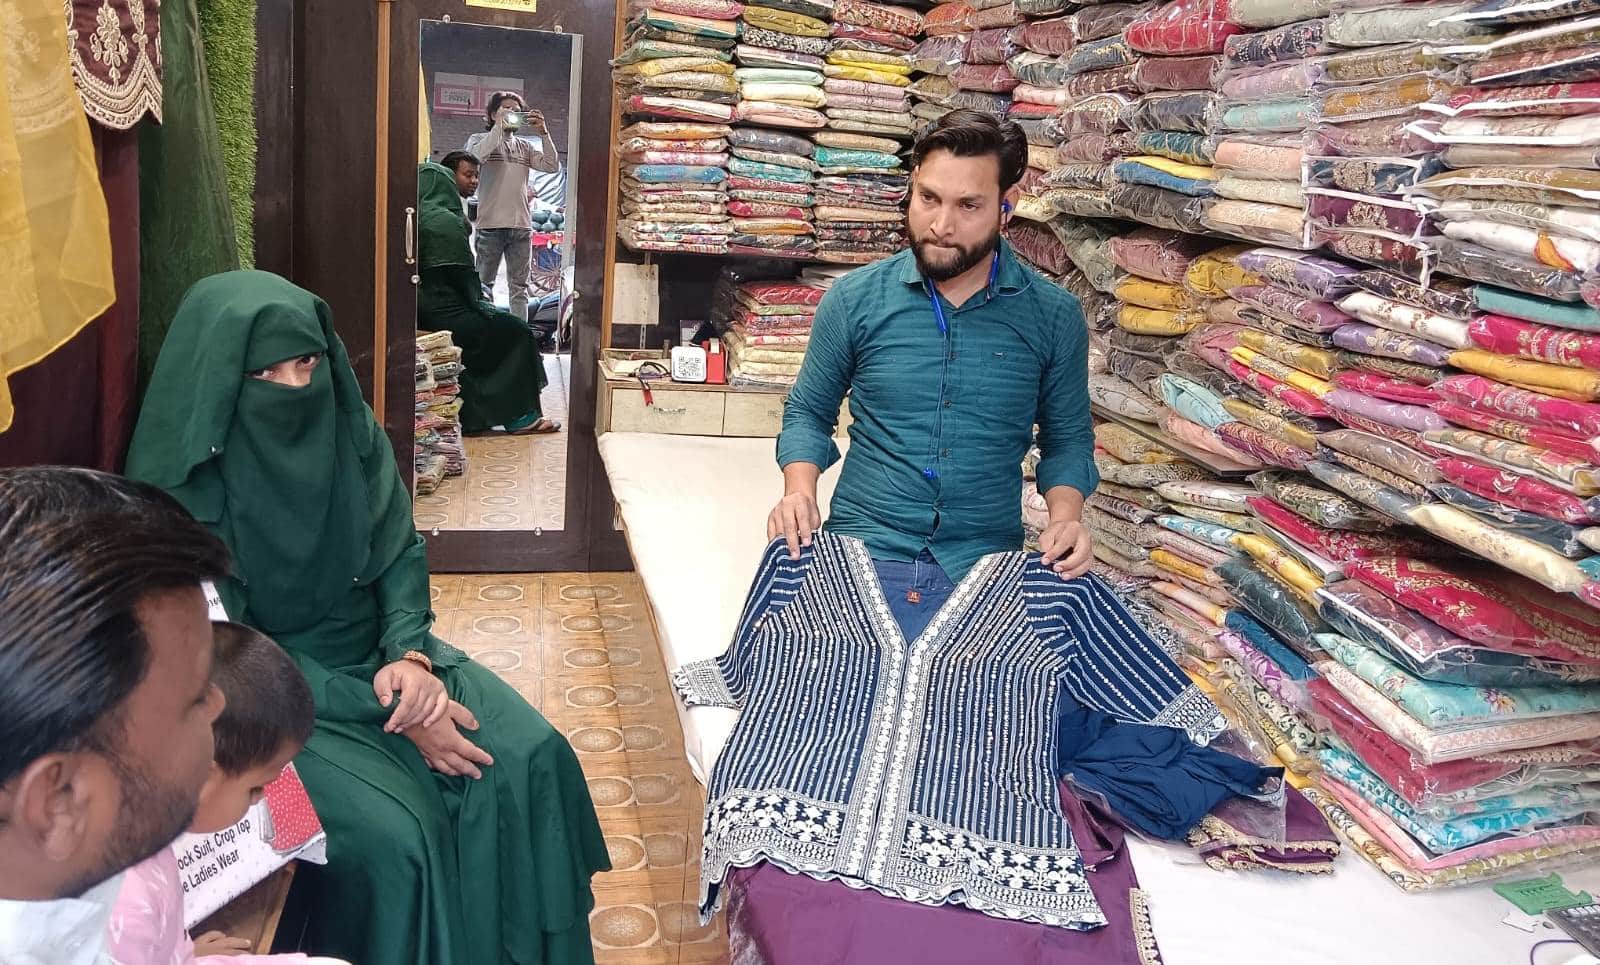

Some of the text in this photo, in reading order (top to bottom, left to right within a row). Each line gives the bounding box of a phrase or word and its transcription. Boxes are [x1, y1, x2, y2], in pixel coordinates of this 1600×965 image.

[178, 850, 195, 870] ock
[194, 840, 215, 860] Suit,
[214, 829, 236, 848] Crop
[188, 863, 218, 888] Ladies
[216, 849, 240, 870] Wear
